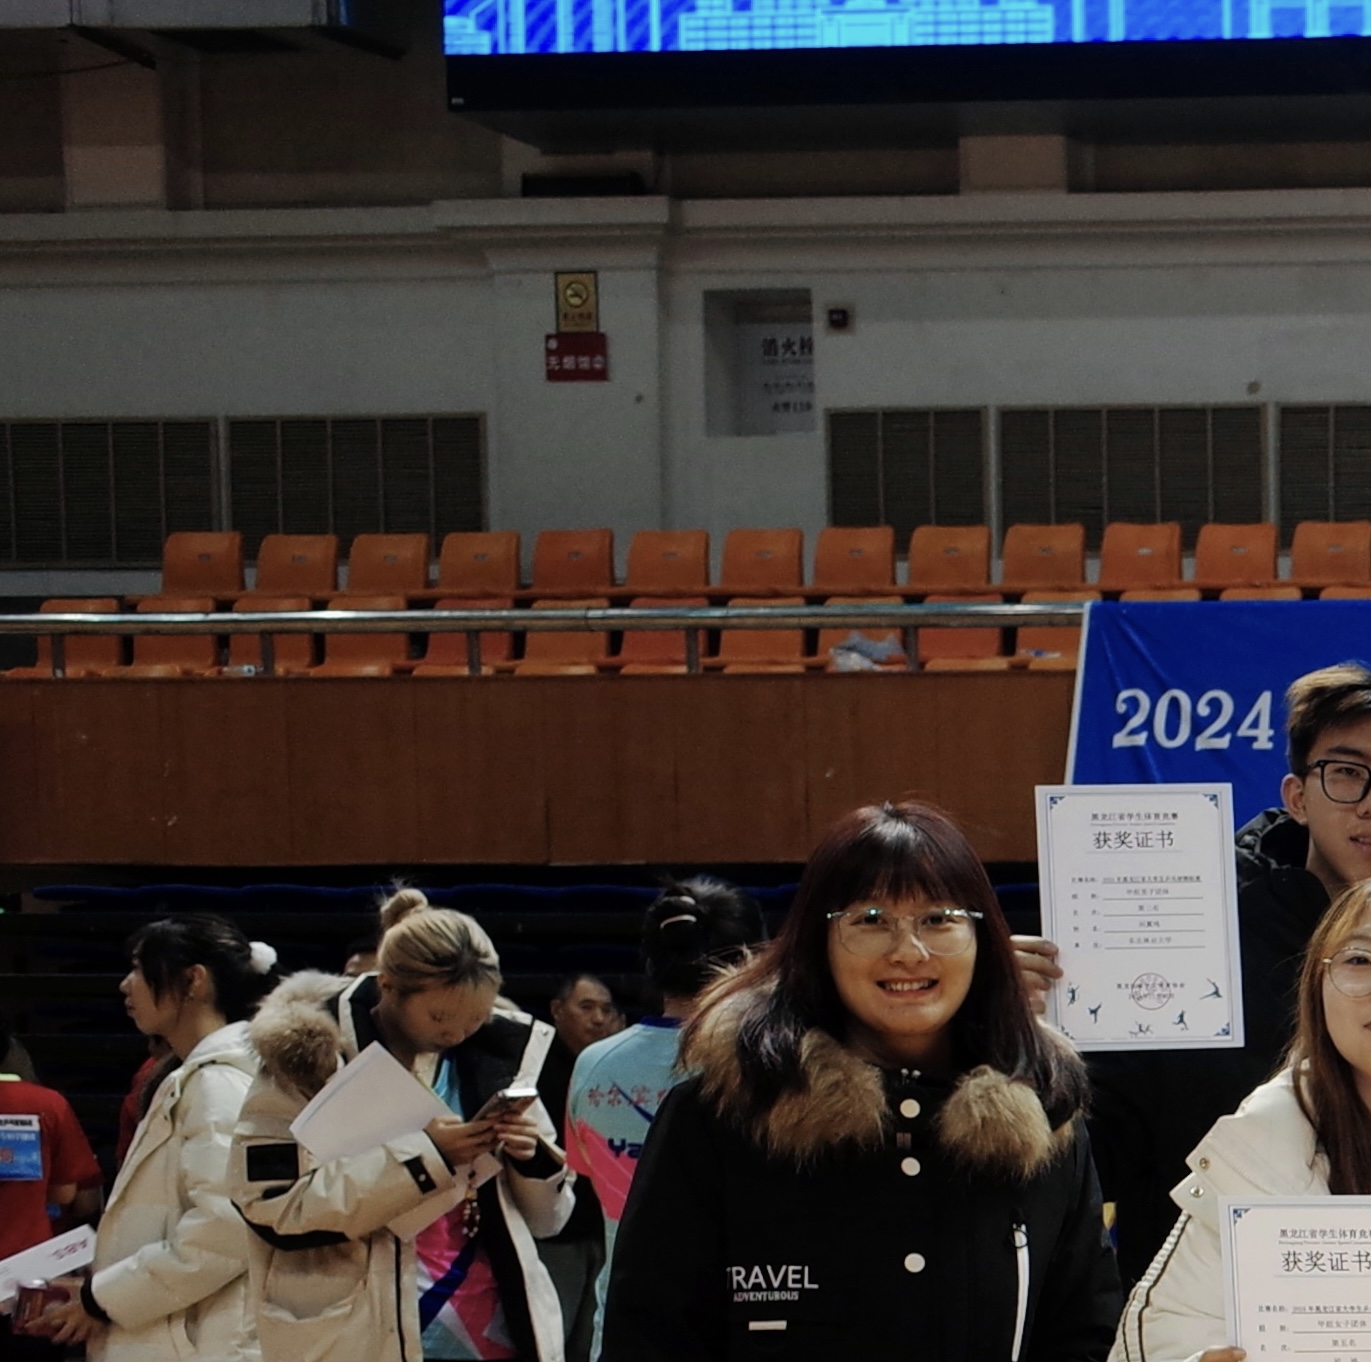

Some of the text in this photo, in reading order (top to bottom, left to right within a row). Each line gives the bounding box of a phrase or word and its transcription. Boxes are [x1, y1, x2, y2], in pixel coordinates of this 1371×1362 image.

[1093, 830, 1174, 849] 获奖证书
[734, 1290, 800, 1302] ADVENTUROUS
